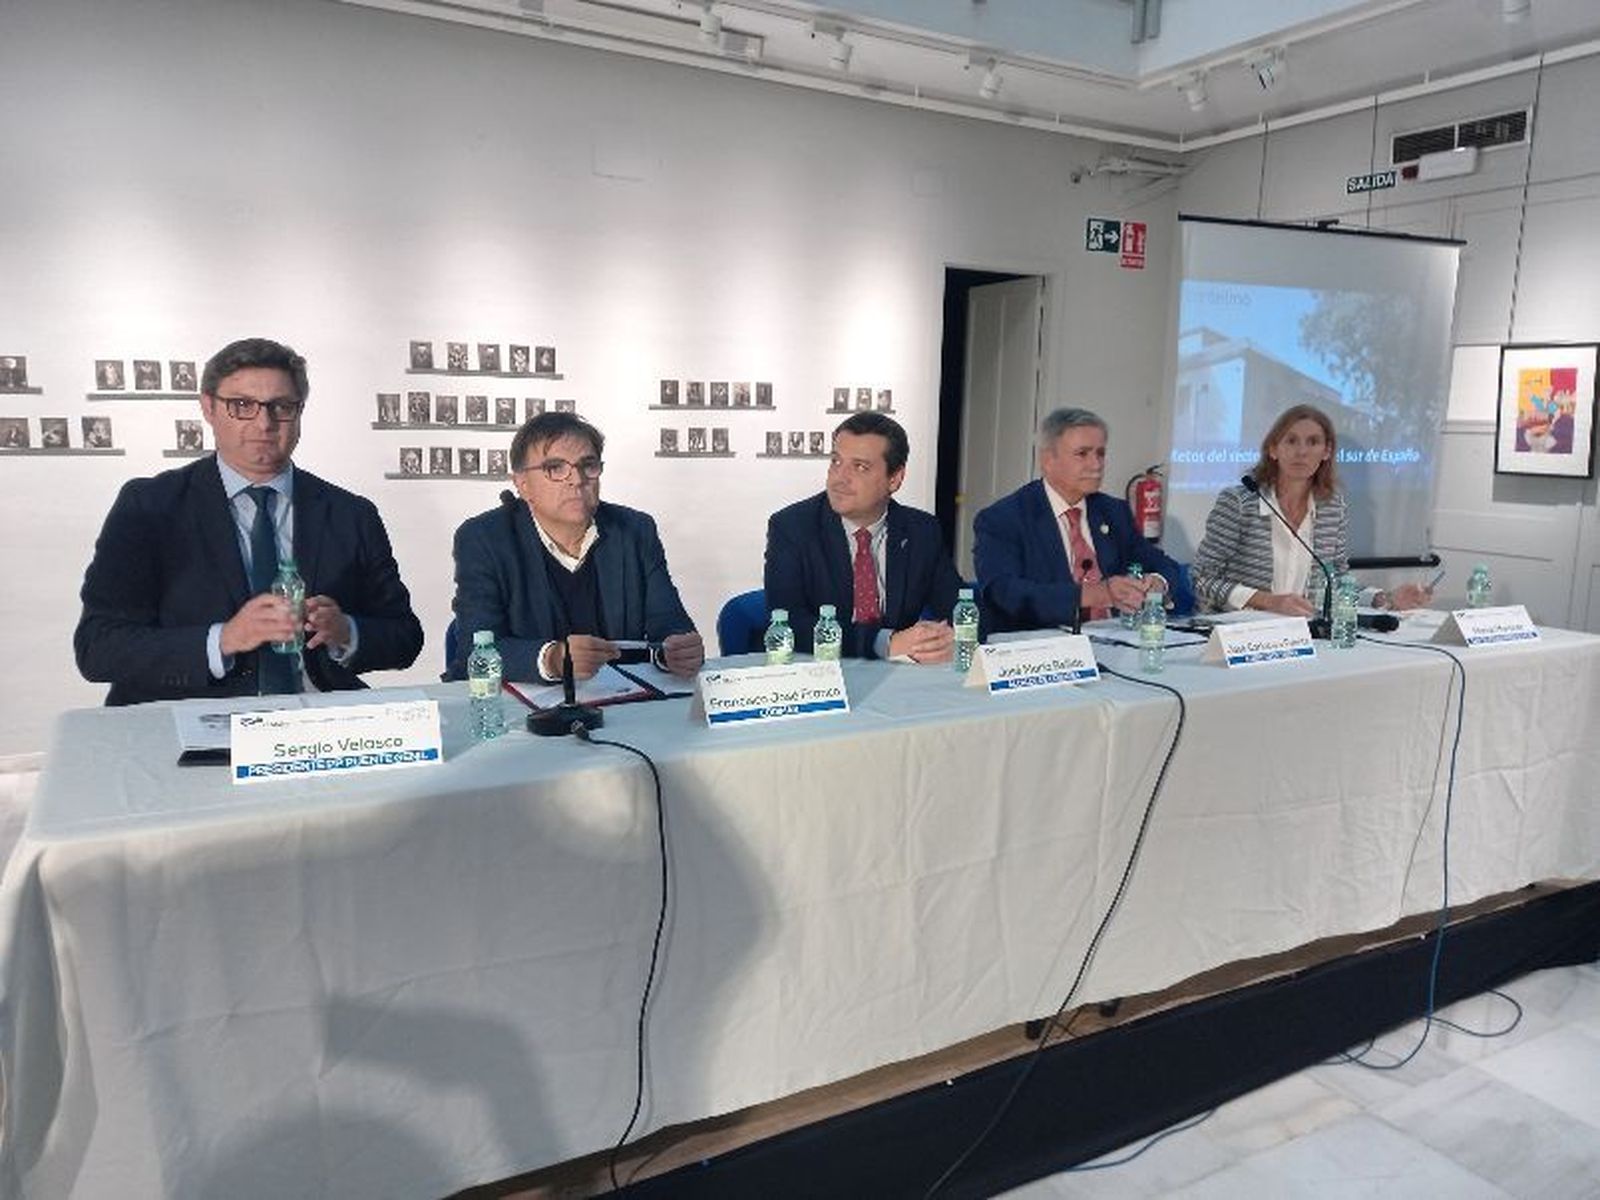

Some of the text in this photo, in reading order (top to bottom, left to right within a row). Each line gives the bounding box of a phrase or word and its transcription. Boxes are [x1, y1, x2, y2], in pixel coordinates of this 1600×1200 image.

[1348, 171, 1394, 192] SALIDA
[1381, 446, 1420, 466] España
[274, 736, 405, 759] Sergio Velasco
